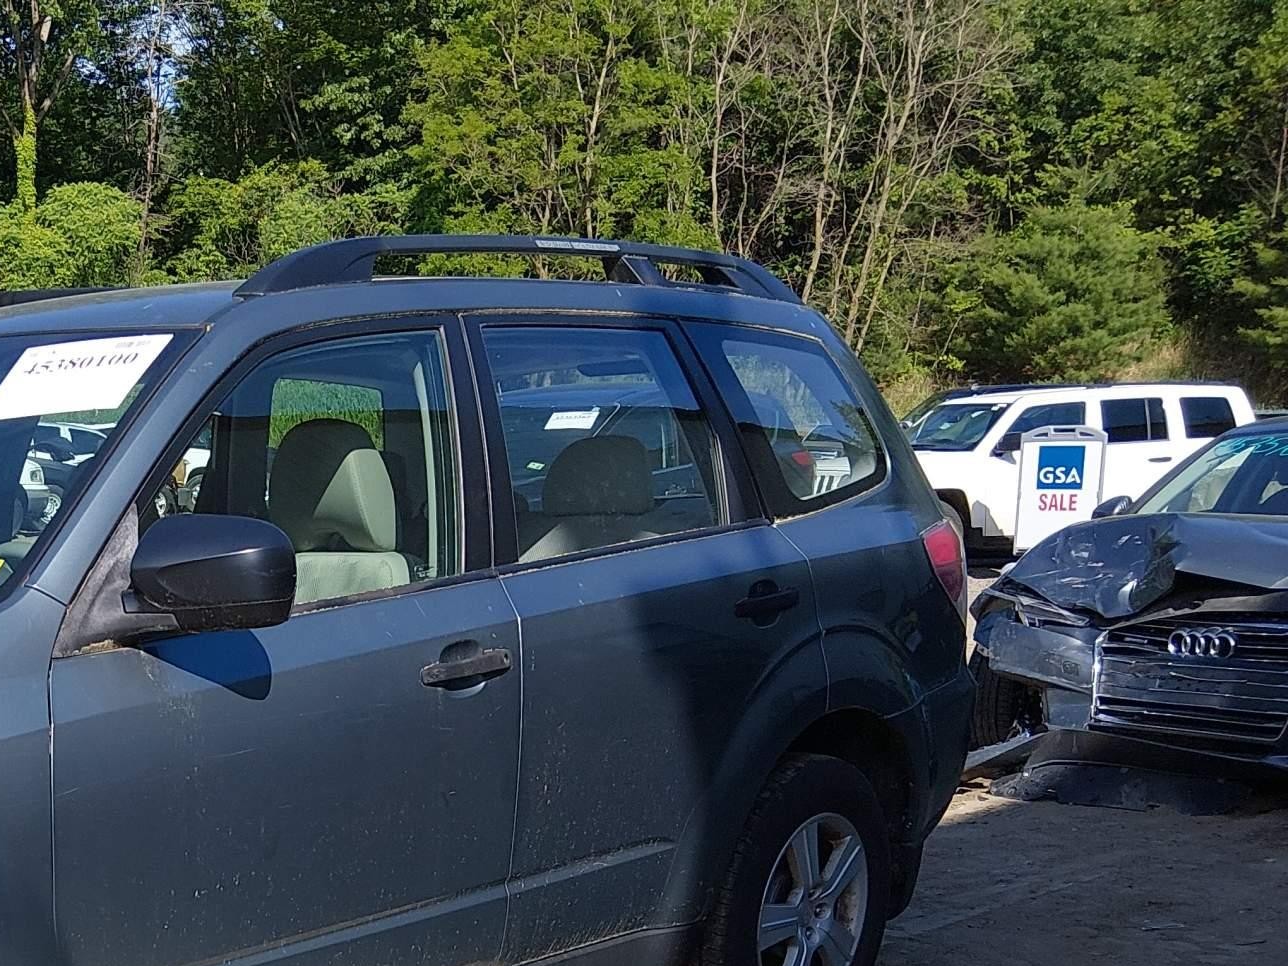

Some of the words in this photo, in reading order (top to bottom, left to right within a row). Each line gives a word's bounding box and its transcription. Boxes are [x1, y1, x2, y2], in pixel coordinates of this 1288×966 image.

[23, 352, 139, 375] 45380100
[1039, 466, 1082, 484] GSA
[1038, 493, 1079, 512] SALE
